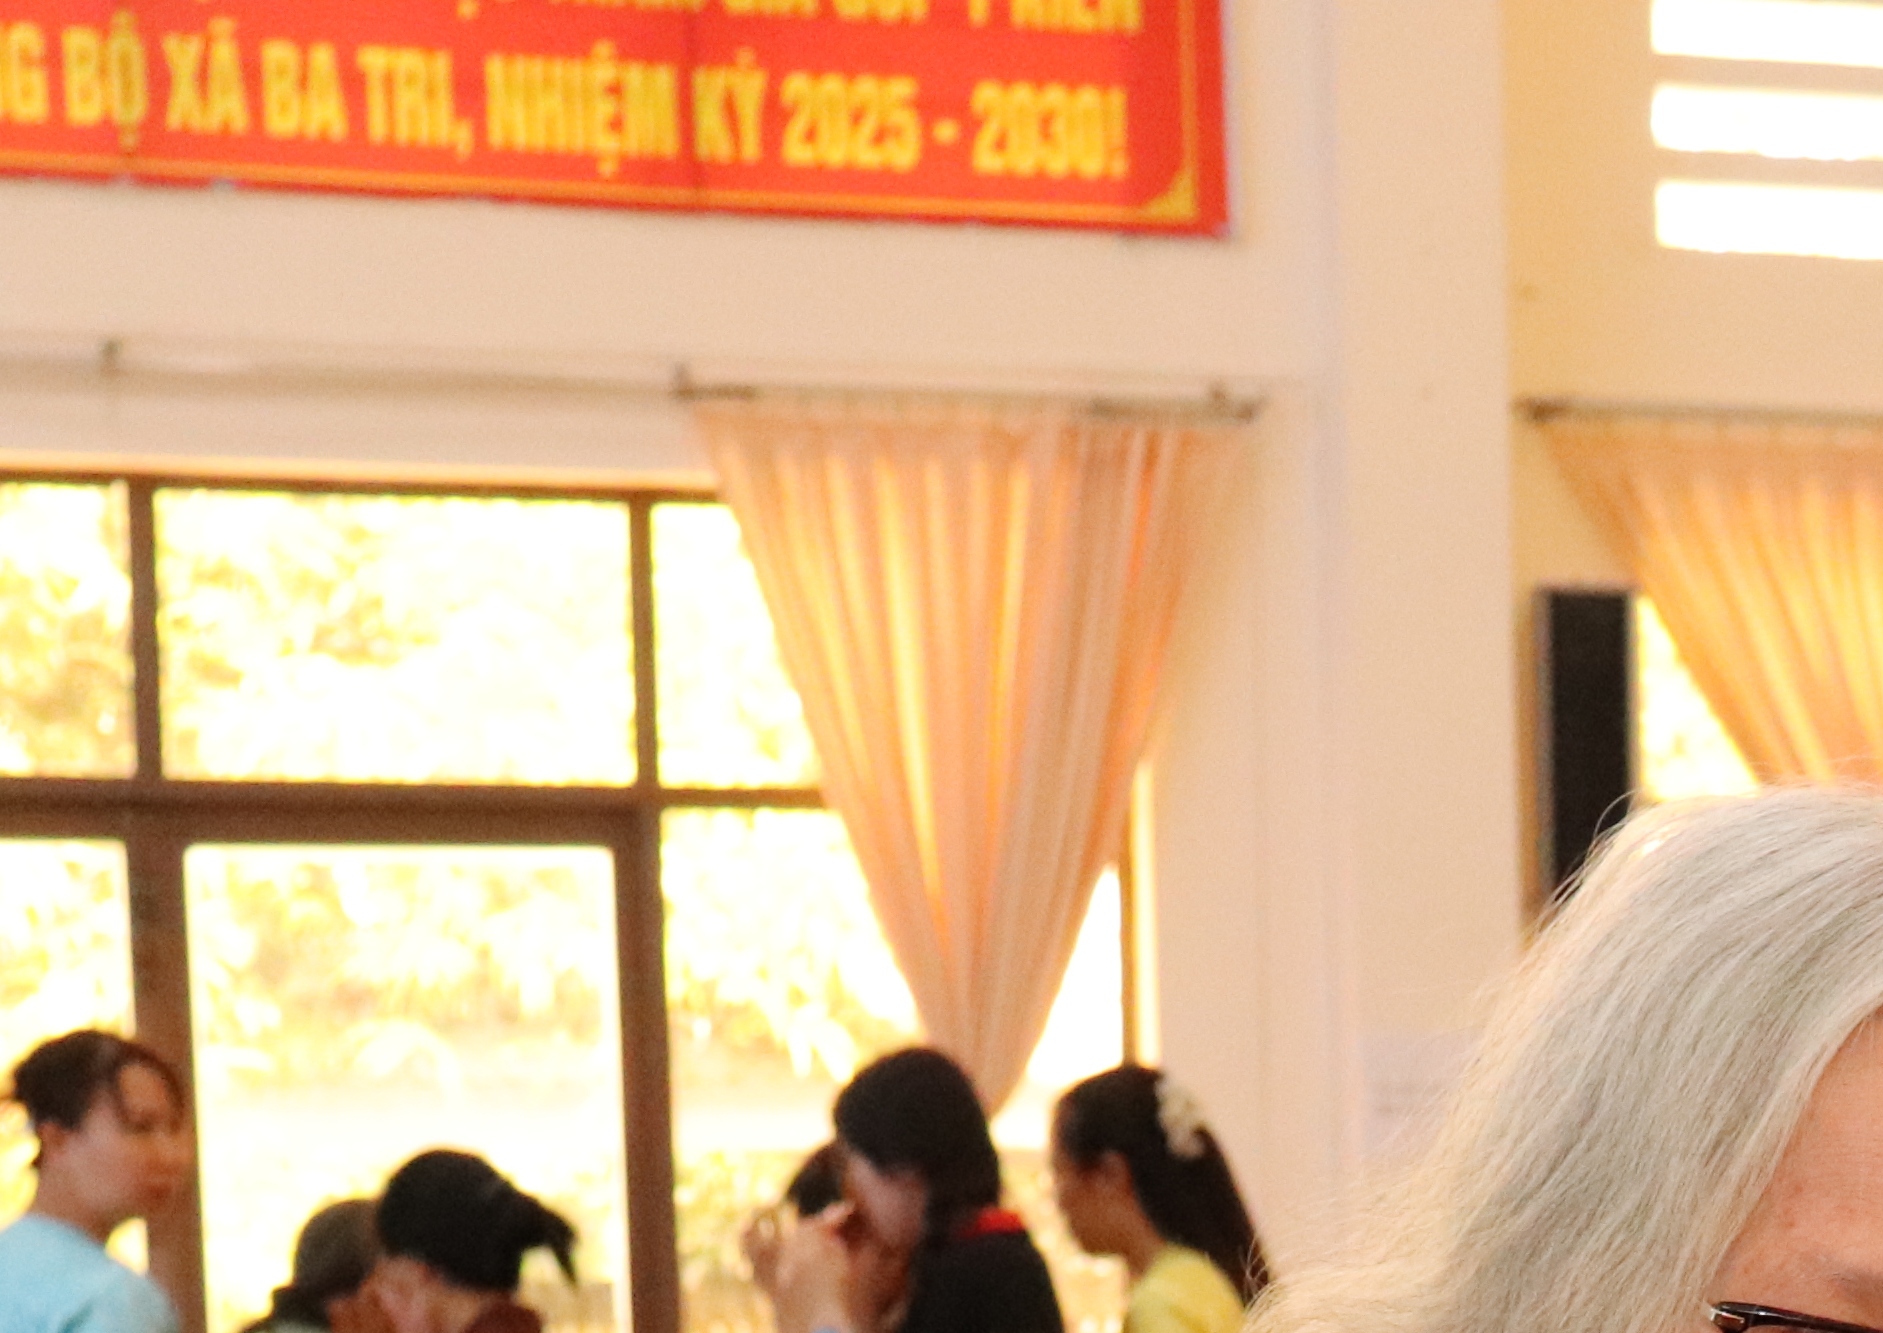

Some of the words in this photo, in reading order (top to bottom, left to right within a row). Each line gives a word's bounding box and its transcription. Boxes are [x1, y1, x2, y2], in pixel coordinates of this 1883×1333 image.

[60, 8, 149, 152] BỘ
[161, 15, 250, 136] XÃ
[260, 38, 348, 142] BA
[356, 44, 473, 162] TRI,
[484, 39, 678, 177] NHIỆM
[779, 70, 922, 173] 2025
[971, 81, 1130, 181] 2030!
